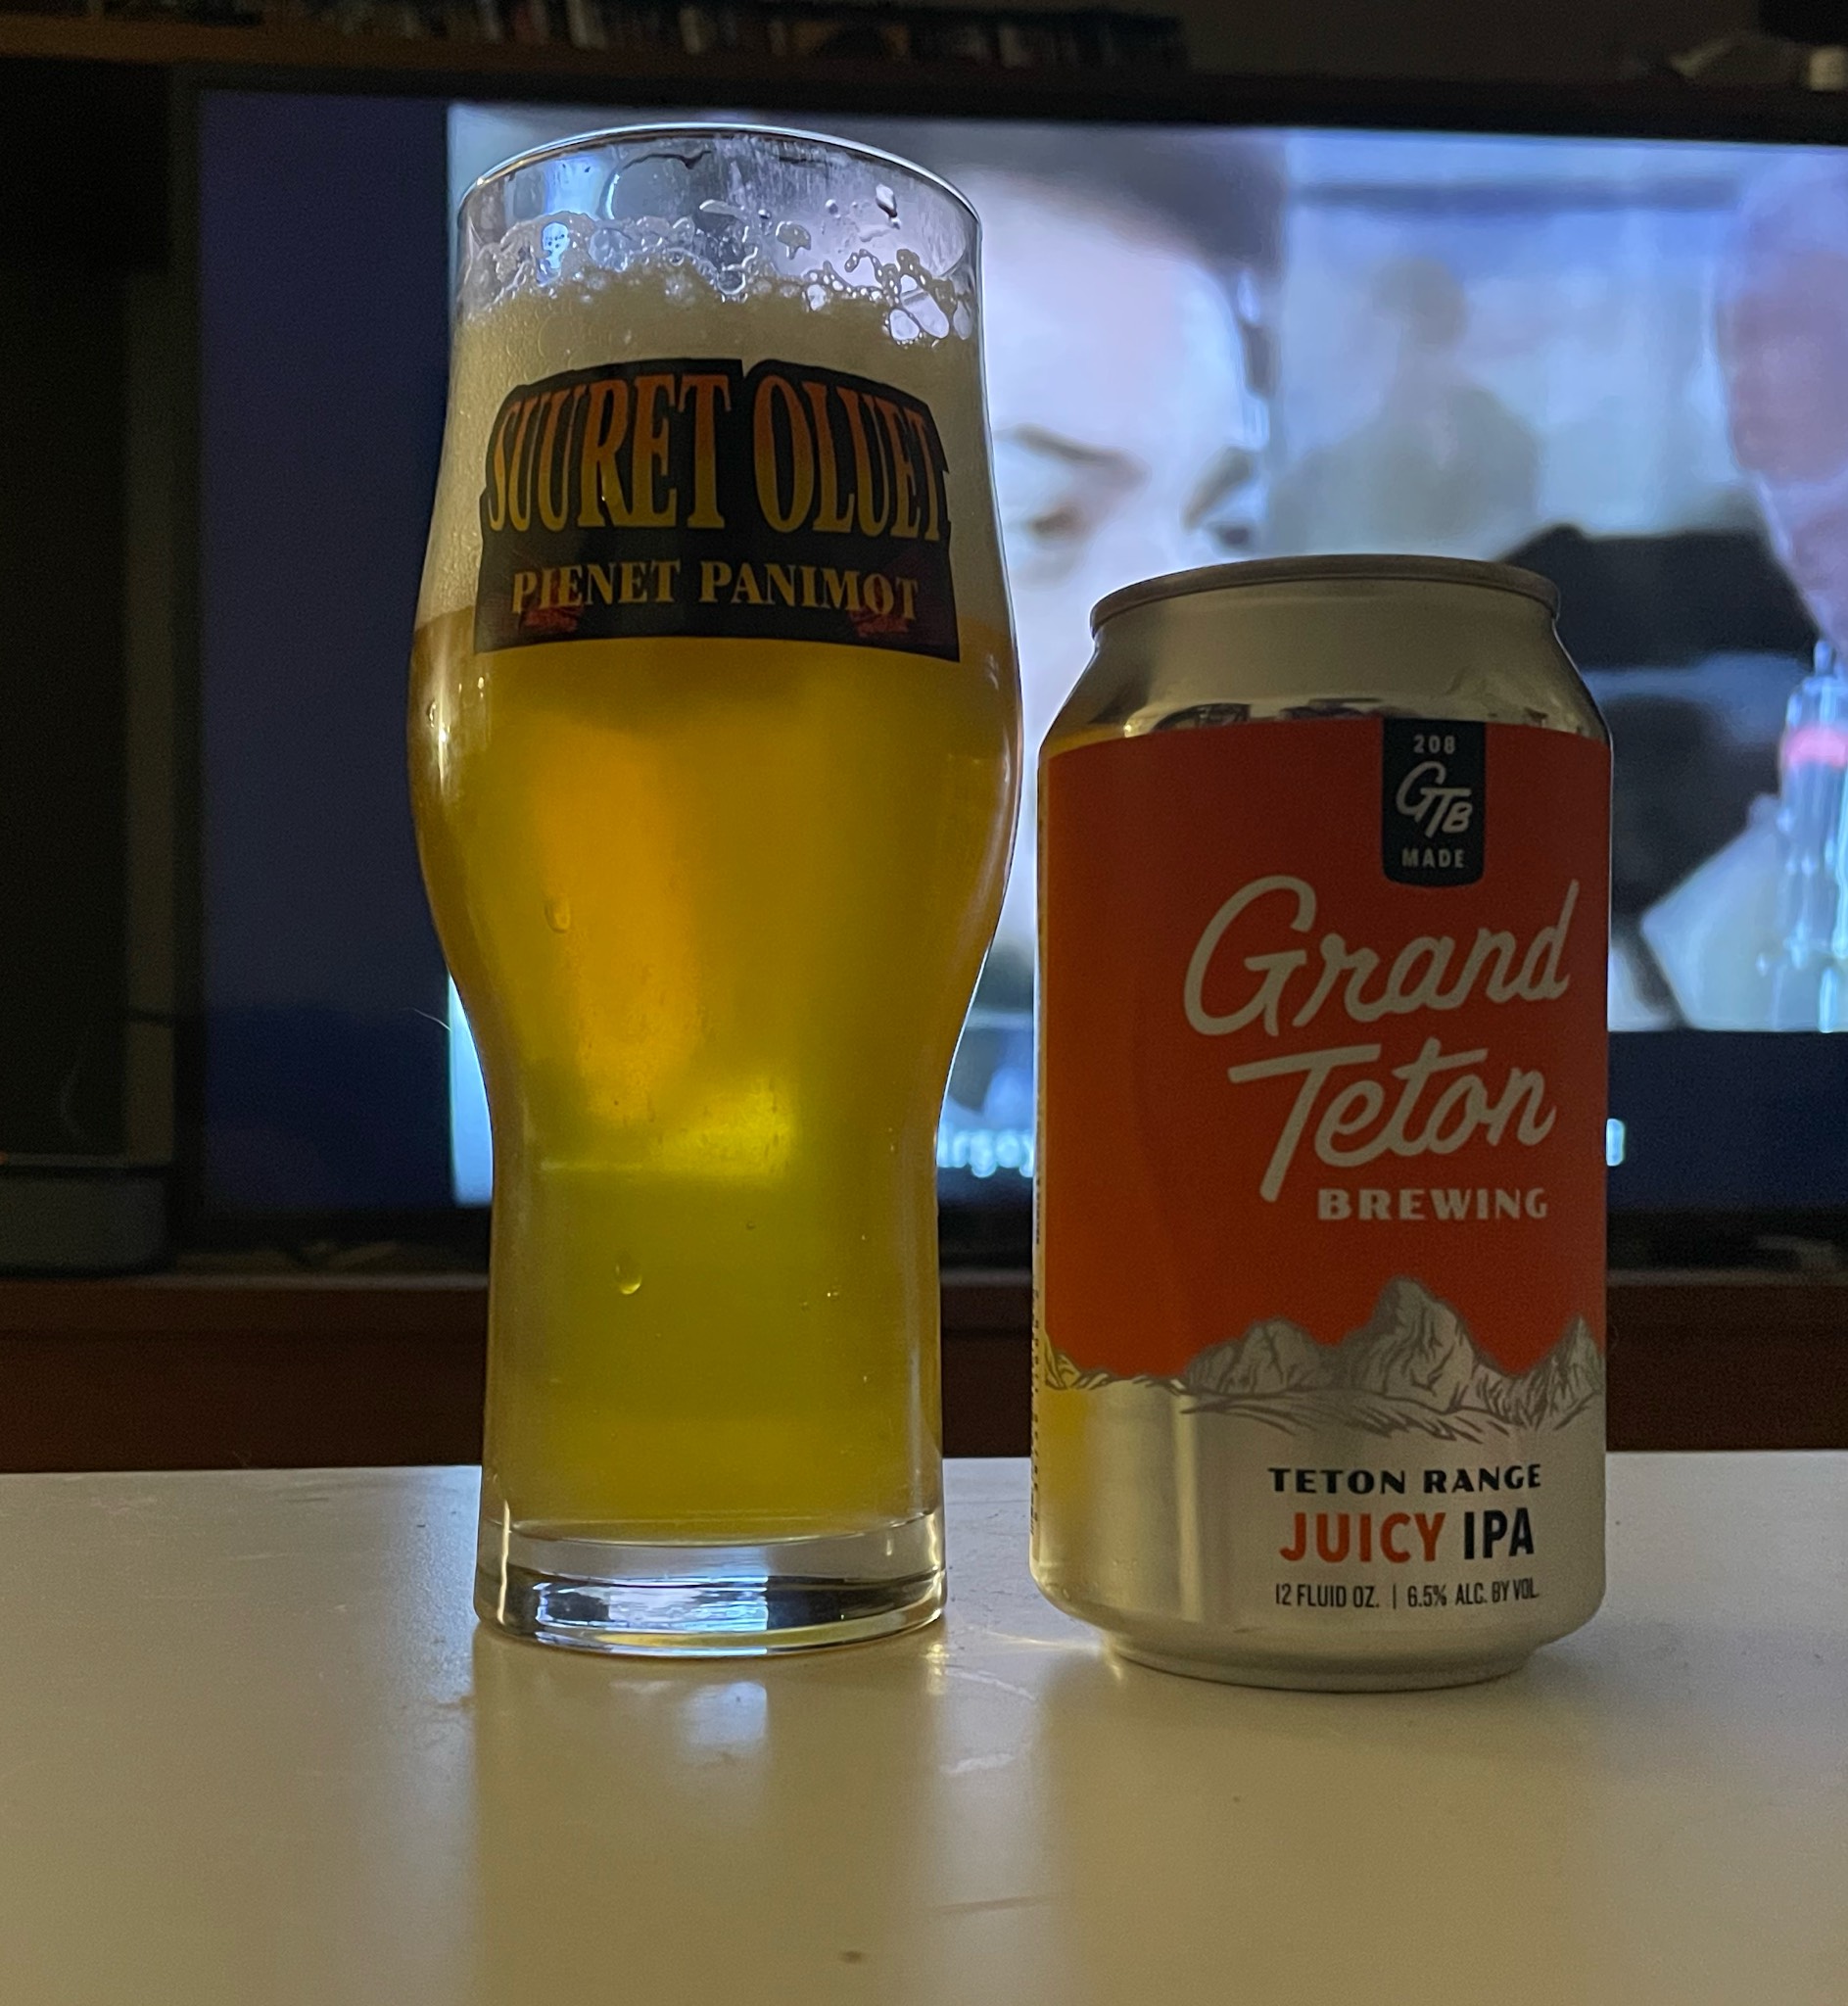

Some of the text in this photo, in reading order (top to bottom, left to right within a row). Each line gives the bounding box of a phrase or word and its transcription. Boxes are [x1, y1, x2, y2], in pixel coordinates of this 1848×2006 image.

[489, 373, 940, 543] SUURET OLUET
[511, 558, 919, 621] PIENET PANIMOT
[1412, 734, 1456, 755] 208
[1395, 760, 1474, 839] GTB
[1401, 848, 1466, 870] MADE
[1183, 875, 1580, 1036] Grand
[1227, 1036, 1557, 1204] Teton
[1317, 1186, 1549, 1221] BREWING
[1267, 1463, 1541, 1495] TETON RANGE
[1278, 1507, 1535, 1563] JUICY IPA
[1275, 1583, 1292, 1605] 12
[1297, 1584, 1347, 1608] FLUID
[1352, 1585, 1380, 1609] OZ.
[1407, 1584, 1447, 1608] 6.5%
[1454, 1581, 1488, 1606] ALC.
[1492, 1578, 1510, 1603] BY
